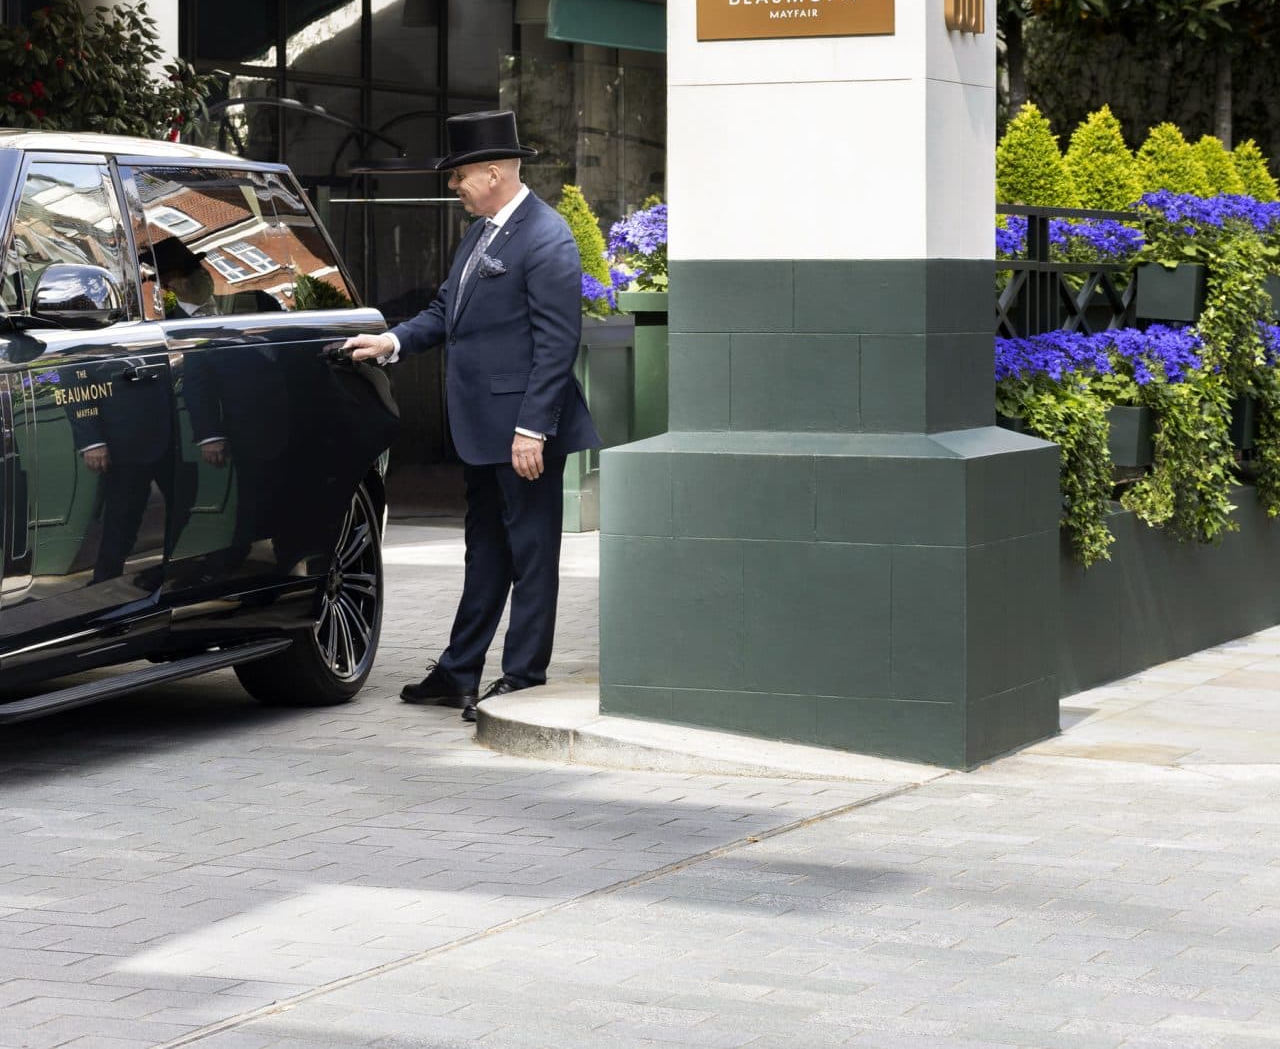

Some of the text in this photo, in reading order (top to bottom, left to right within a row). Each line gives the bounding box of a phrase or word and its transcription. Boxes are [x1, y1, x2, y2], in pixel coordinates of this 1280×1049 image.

[769, 8, 819, 19] MAYFAIR
[76, 370, 87, 379] THE
[54, 382, 112, 405] BEAUMONT
[76, 407, 98, 418] MAYFAIR
